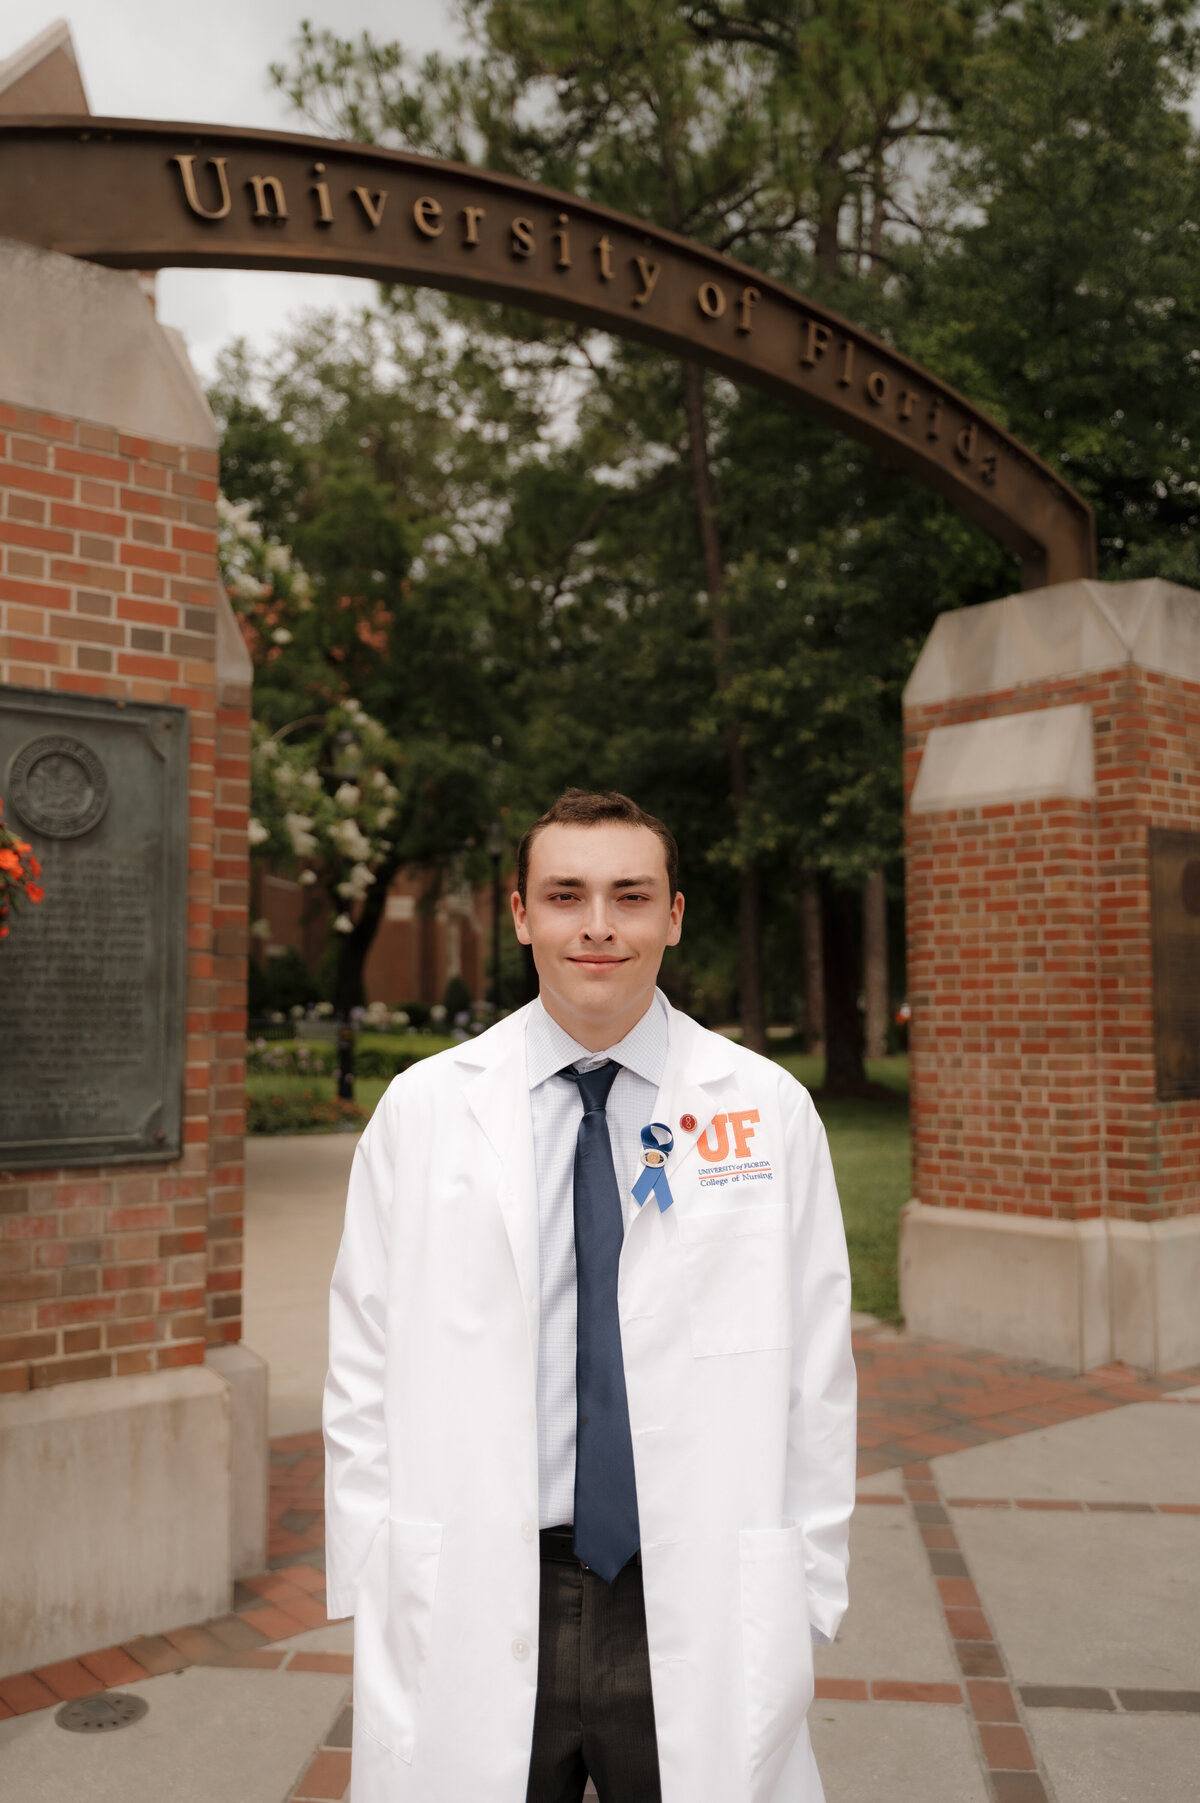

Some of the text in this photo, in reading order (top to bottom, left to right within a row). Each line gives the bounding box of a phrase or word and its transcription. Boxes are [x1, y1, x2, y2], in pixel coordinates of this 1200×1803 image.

[172, 153, 997, 485] University of Florida
[697, 1109, 760, 1162] UF
[698, 1165, 736, 1174] UNIVERSITY
[744, 1161, 770, 1169] FLORIDA
[700, 1172, 773, 1186] College of Nursing
